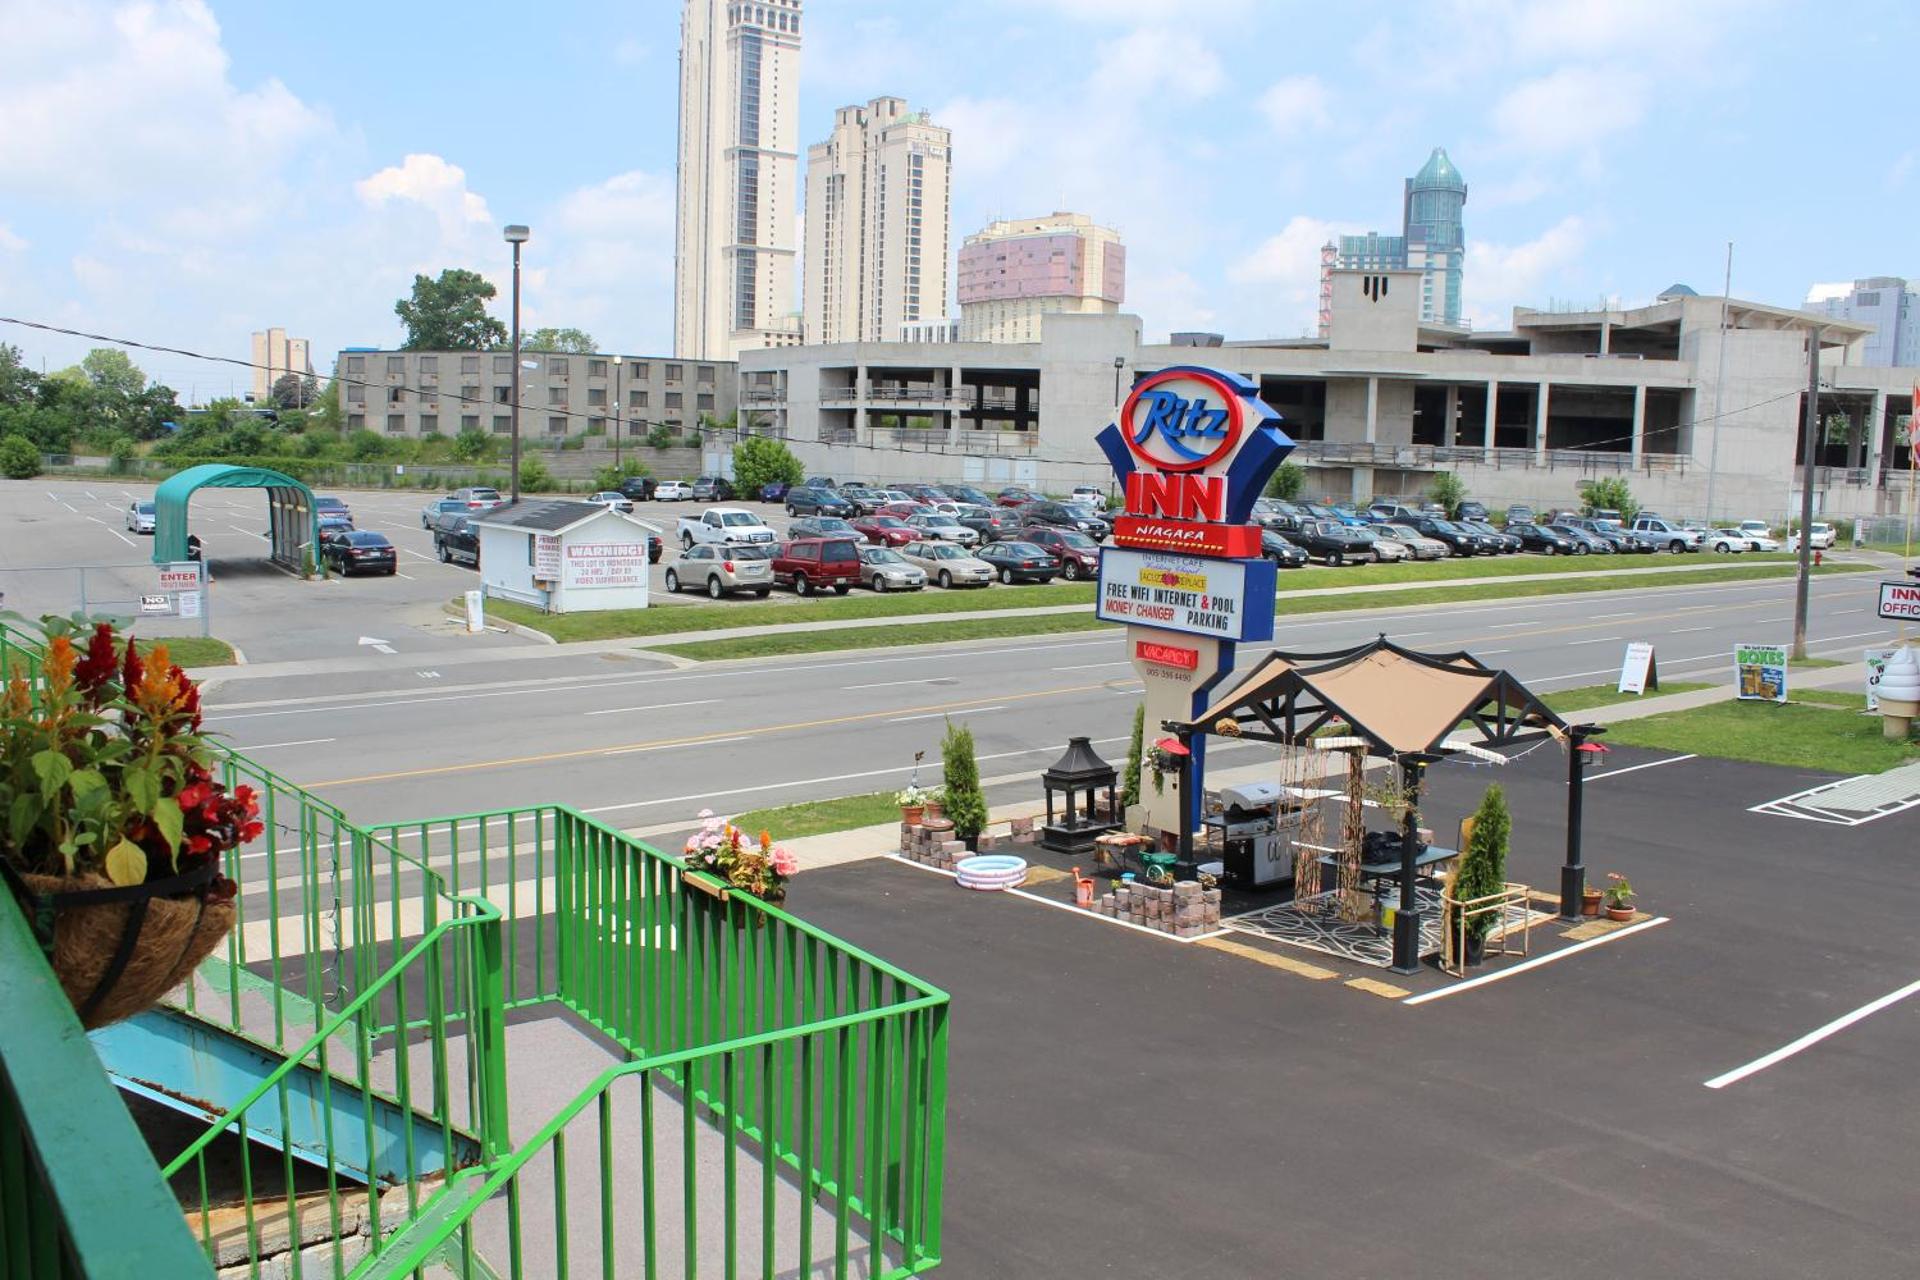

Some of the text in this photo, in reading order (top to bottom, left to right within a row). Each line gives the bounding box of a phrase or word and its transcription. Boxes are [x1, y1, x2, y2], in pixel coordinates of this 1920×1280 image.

[1132, 390, 1230, 460] Ritz
[1125, 471, 1228, 523] INN
[1136, 525, 1205, 541] NIAGARA
[571, 546, 643, 557] WARNING!
[161, 573, 196, 581] ENTER
[1107, 583, 1235, 613] FREE WIFI INTERNET & POOL
[1891, 588, 1920, 601] INN
[1105, 599, 1228, 630] MONEY CHANGER PARKING
[1882, 602, 1920, 616] OFFIC
[1143, 644, 1191, 665] VACANCY
[1737, 650, 1784, 666] BOXES
